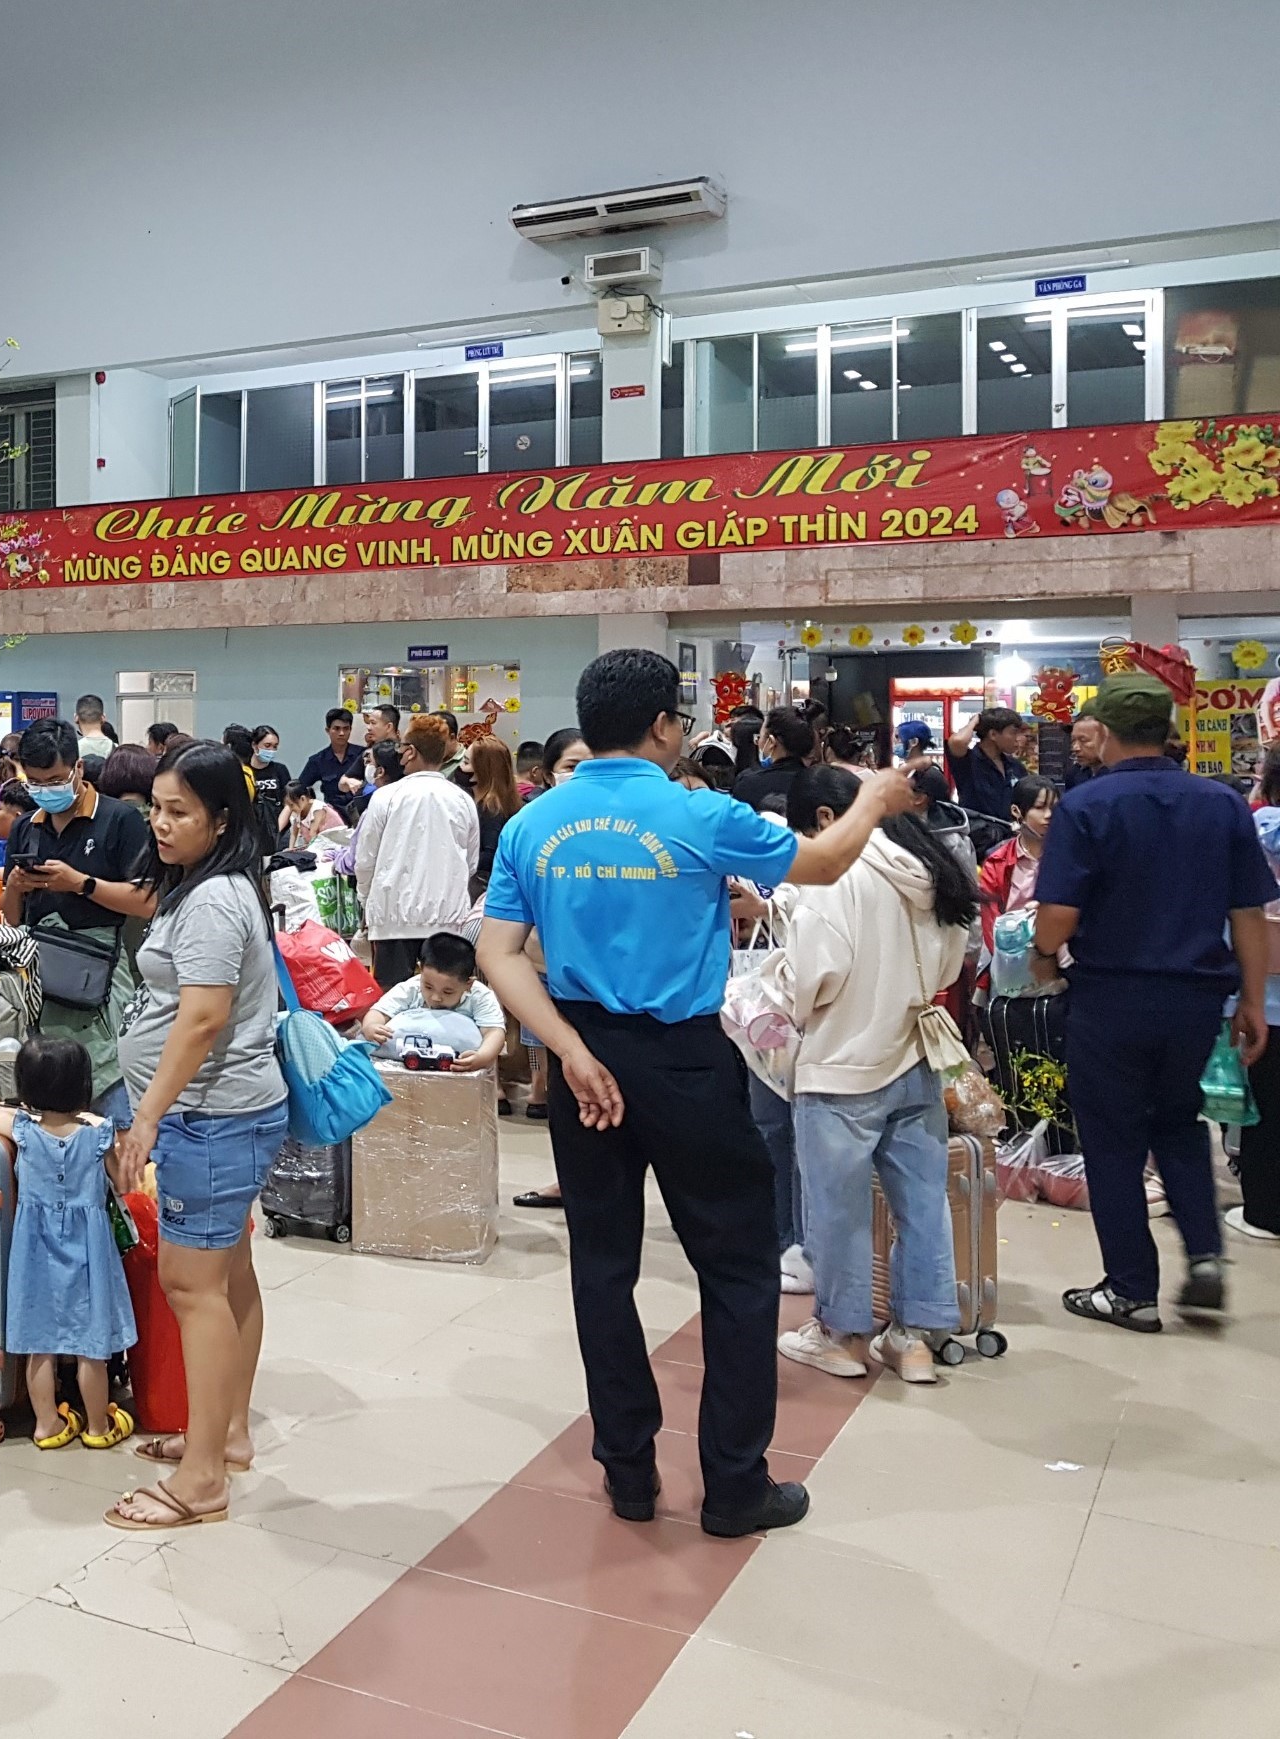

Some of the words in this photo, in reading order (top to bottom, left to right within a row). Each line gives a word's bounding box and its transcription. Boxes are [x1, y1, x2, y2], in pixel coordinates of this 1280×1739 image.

[1039, 282, 1051, 292] VĂN
[1052, 280, 1073, 291] PHÒNG
[1073, 280, 1082, 288] GA
[96, 504, 248, 543] Chúc
[259, 490, 476, 532] Mừng
[499, 471, 723, 515] Năm
[734, 449, 932, 499] Mới
[64, 549, 142, 583] MỪNG
[150, 546, 231, 579] ĐẢNG
[239, 543, 347, 574] QUANG
[355, 538, 440, 567] VINH,
[452, 528, 554, 561] MỪNG
[565, 519, 664, 555] XUÂN
[676, 511, 769, 549] GIÁP
[780, 504, 866, 543] THÌN
[881, 504, 978, 539] 2024
[22, 707, 56, 720] LIPOVITAN
[1185, 719, 1205, 732] BNH
[1207, 719, 1227, 731] CANH
[556, 824, 575, 841] CÁC
[574, 817, 592, 833] KHU
[594, 815, 612, 830] CHẾ
[639, 831, 663, 853] CÔNG
[551, 866, 570, 878] TP.
[597, 864, 617, 878] CHÍ
[621, 866, 656, 880] MINH
